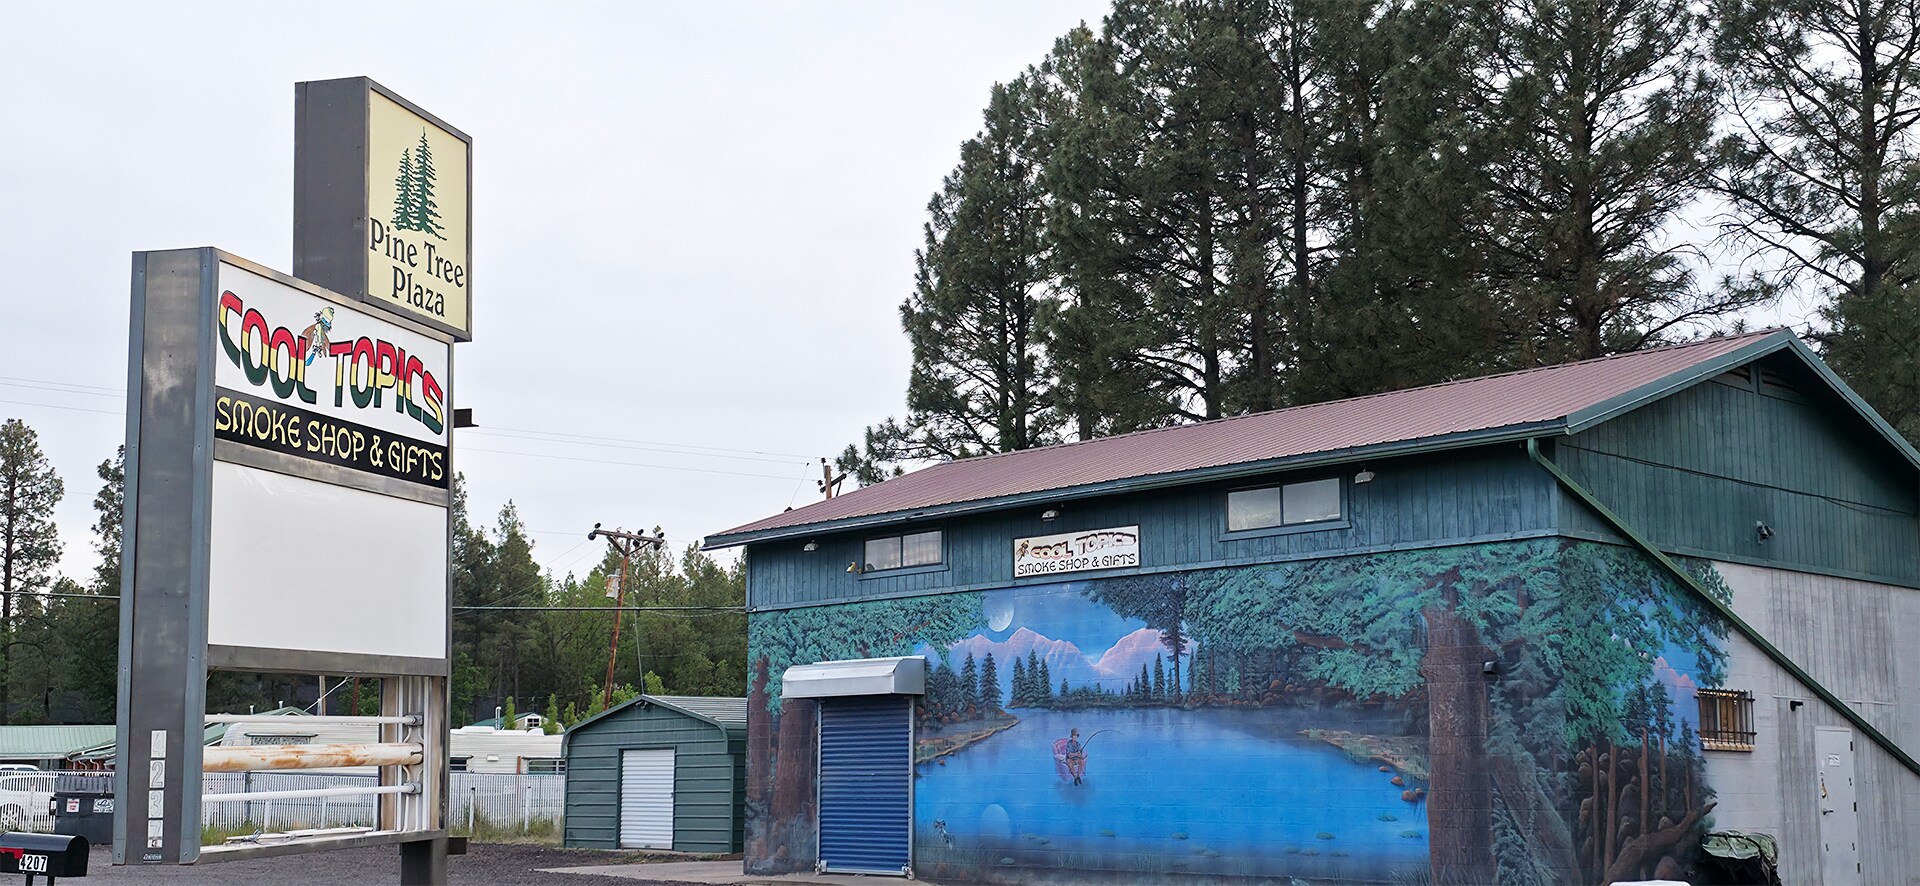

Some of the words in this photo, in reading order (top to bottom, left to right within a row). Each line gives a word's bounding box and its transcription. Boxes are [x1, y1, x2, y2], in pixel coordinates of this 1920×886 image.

[369, 217, 418, 268] Pine
[424, 240, 464, 288] Tree
[391, 265, 445, 317] Plaza
[218, 289, 317, 405] COOL
[329, 335, 444, 436] TOPICS
[215, 396, 302, 448] SMOKE
[307, 419, 365, 461] SHOP
[369, 434, 384, 467] &
[388, 441, 443, 481] GIFTS
[1017, 561, 1057, 575] SMOKE
[1058, 557, 1089, 571] SHOP
[1091, 556, 1099, 568] &
[1101, 553, 1136, 567] GIFTS
[1030, 541, 1074, 560] COOL
[20, 854, 47, 871] 4207
